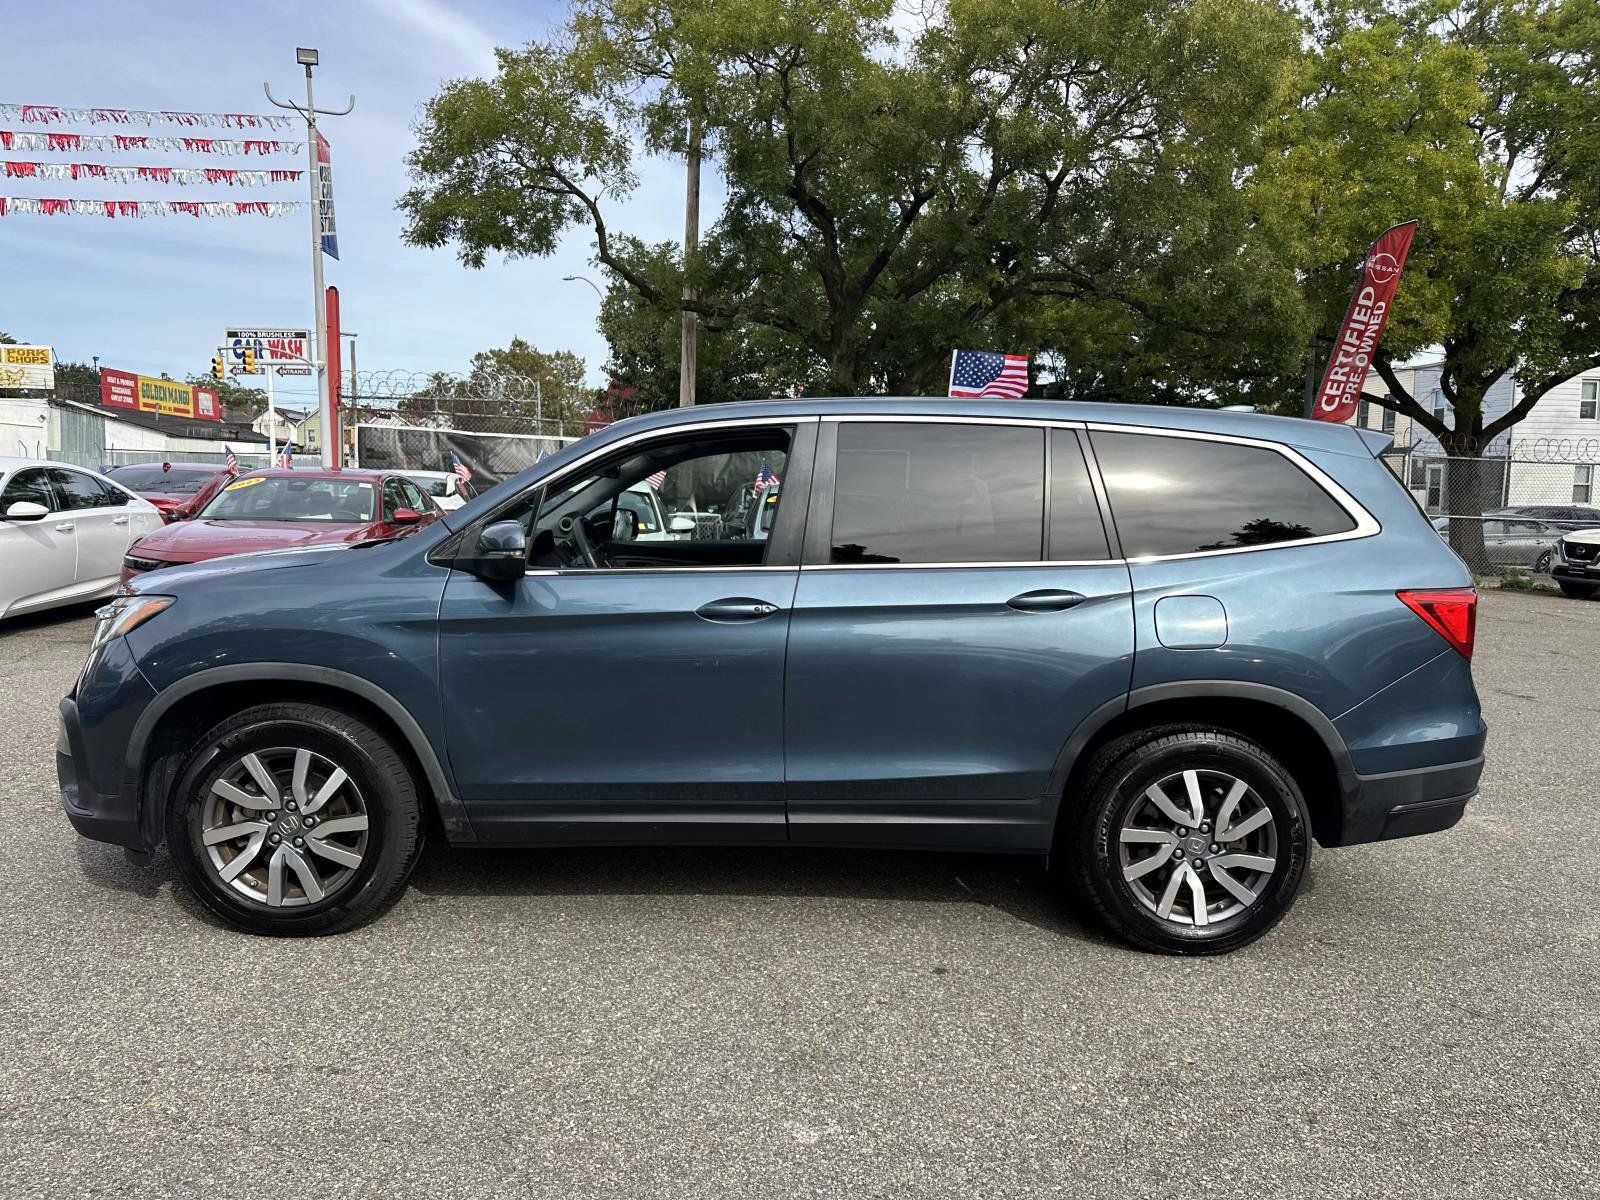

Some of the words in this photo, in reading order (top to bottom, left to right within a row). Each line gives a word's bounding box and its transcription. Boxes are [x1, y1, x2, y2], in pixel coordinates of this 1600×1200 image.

[6, 348, 49, 356] PORK
[7, 356, 49, 364] CHOPS
[267, 339, 303, 360] WASH
[1321, 286, 1375, 412] CERTIFIED
[1341, 301, 1386, 404] PRE-OWNED
[142, 382, 167, 402] GOLDEN
[165, 387, 190, 405] MANGO
